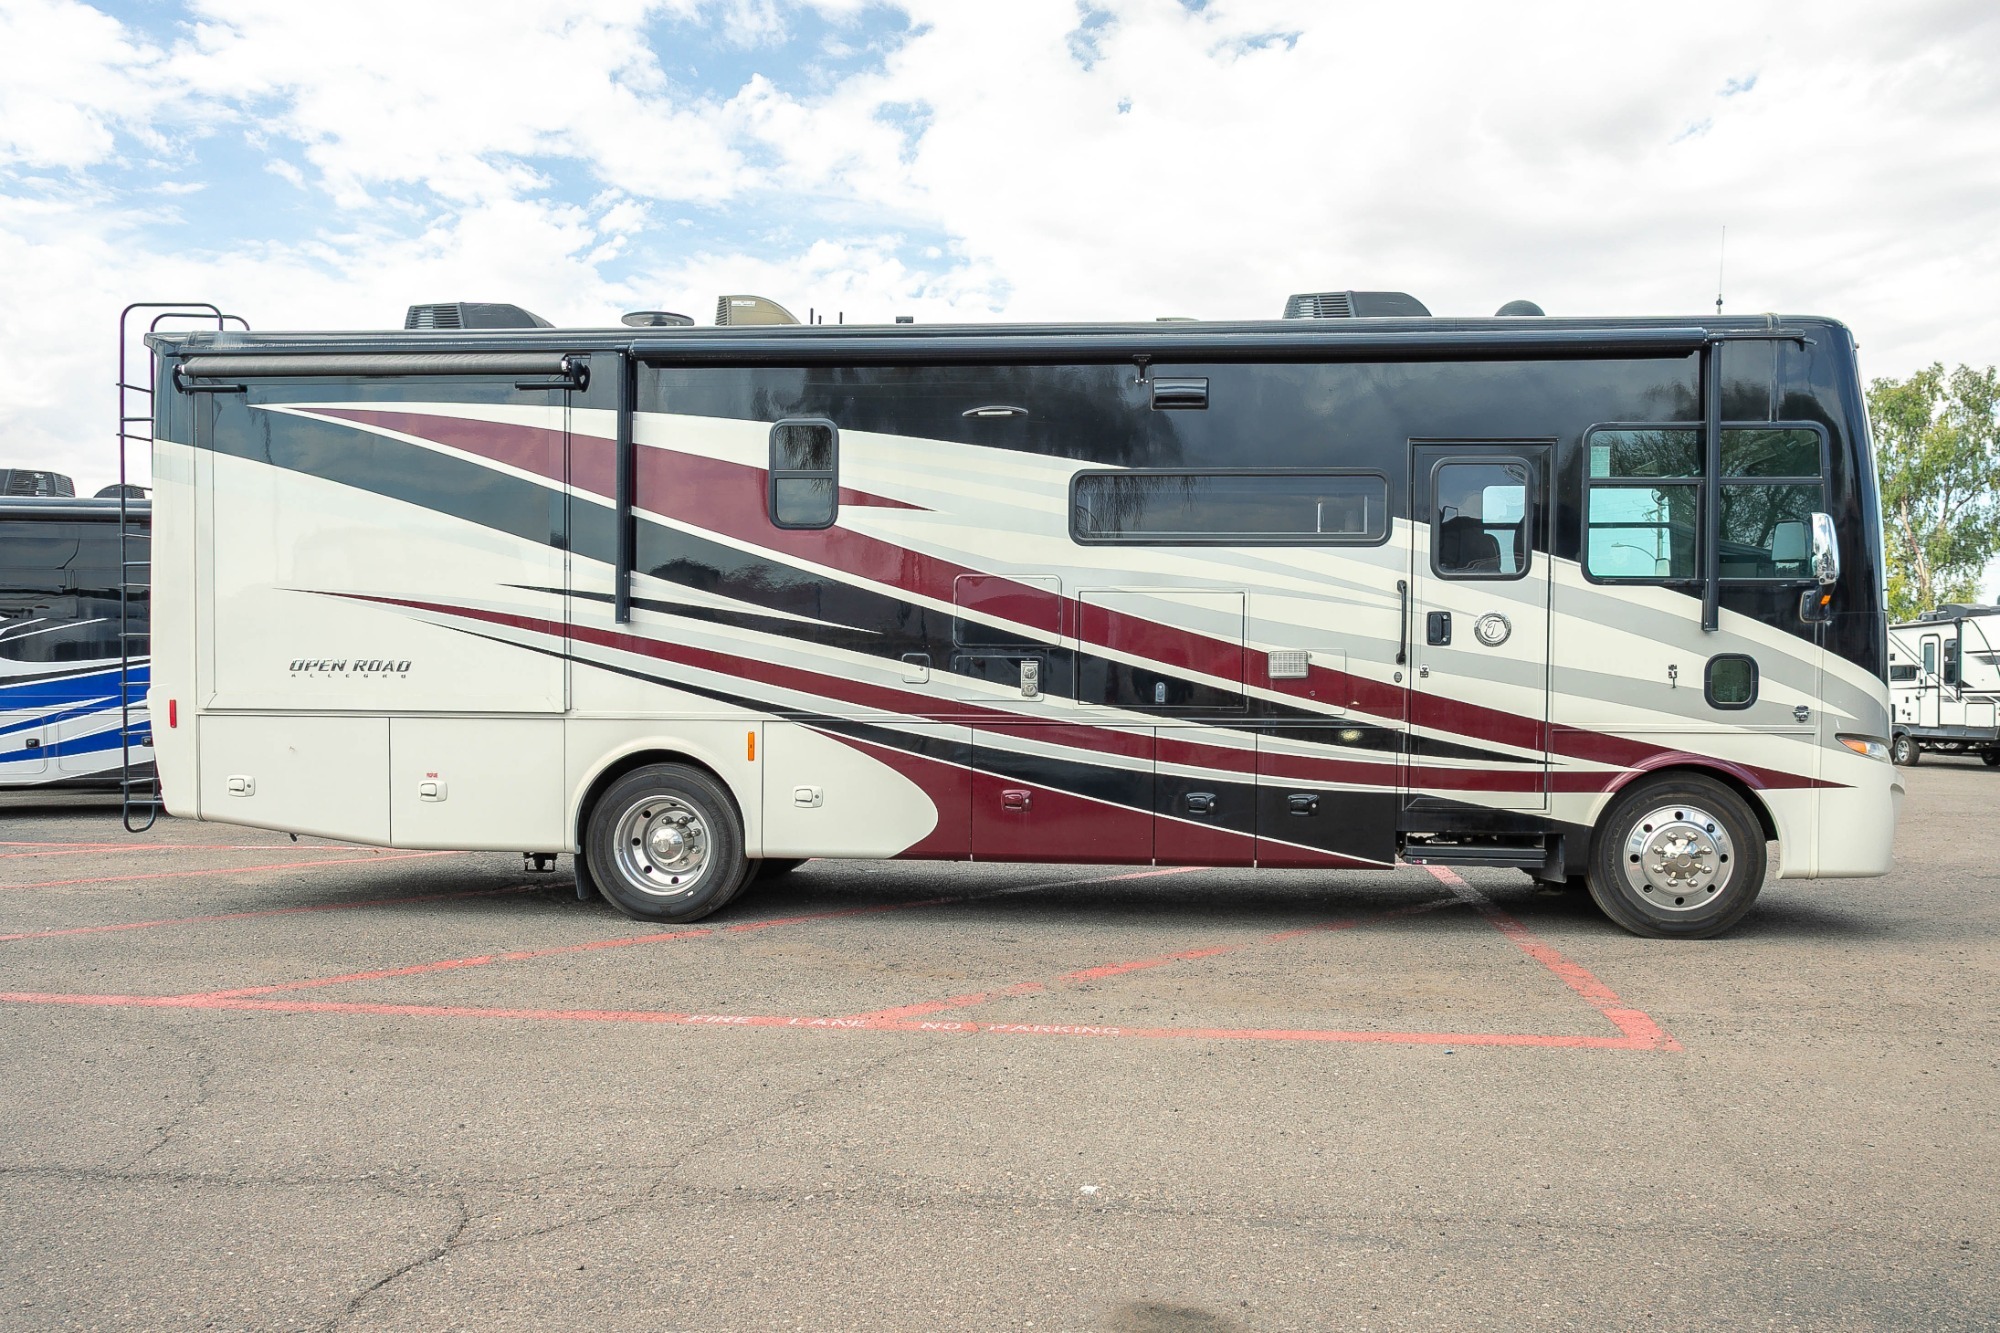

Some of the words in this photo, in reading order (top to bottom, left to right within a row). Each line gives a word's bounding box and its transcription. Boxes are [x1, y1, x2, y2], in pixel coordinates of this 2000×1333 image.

[289, 659, 347, 672] OPEN
[352, 659, 412, 672] ROAD
[687, 1015, 751, 1024] FIRE
[788, 1017, 866, 1027] LANE
[920, 1022, 962, 1030] NO
[988, 1024, 1120, 1035] PARKING
